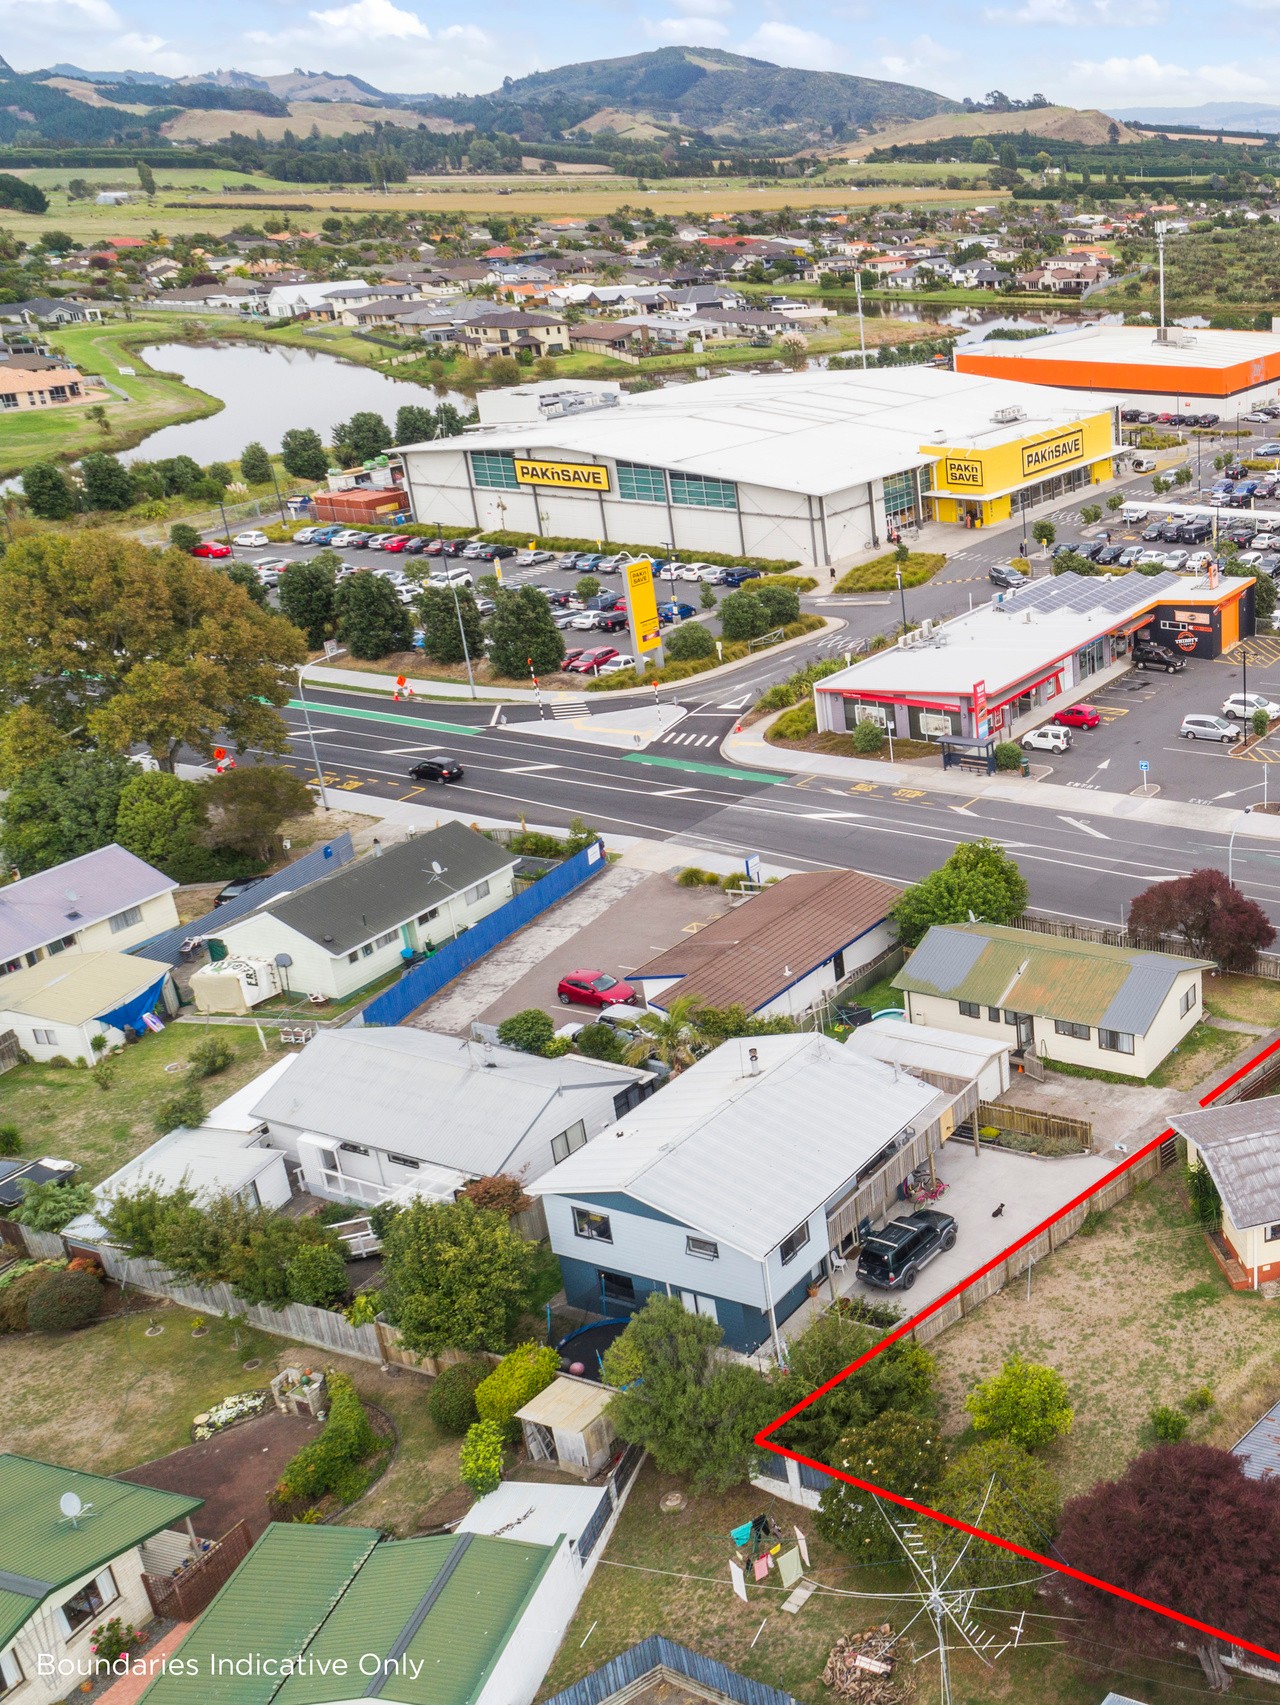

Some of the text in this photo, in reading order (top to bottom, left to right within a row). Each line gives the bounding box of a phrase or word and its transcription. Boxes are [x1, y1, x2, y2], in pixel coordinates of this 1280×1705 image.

[950, 472, 978, 482] SAVE
[1065, 781, 1101, 790] ENTRY
[892, 788, 927, 798] STOP
[1188, 798, 1214, 806] EXIT
